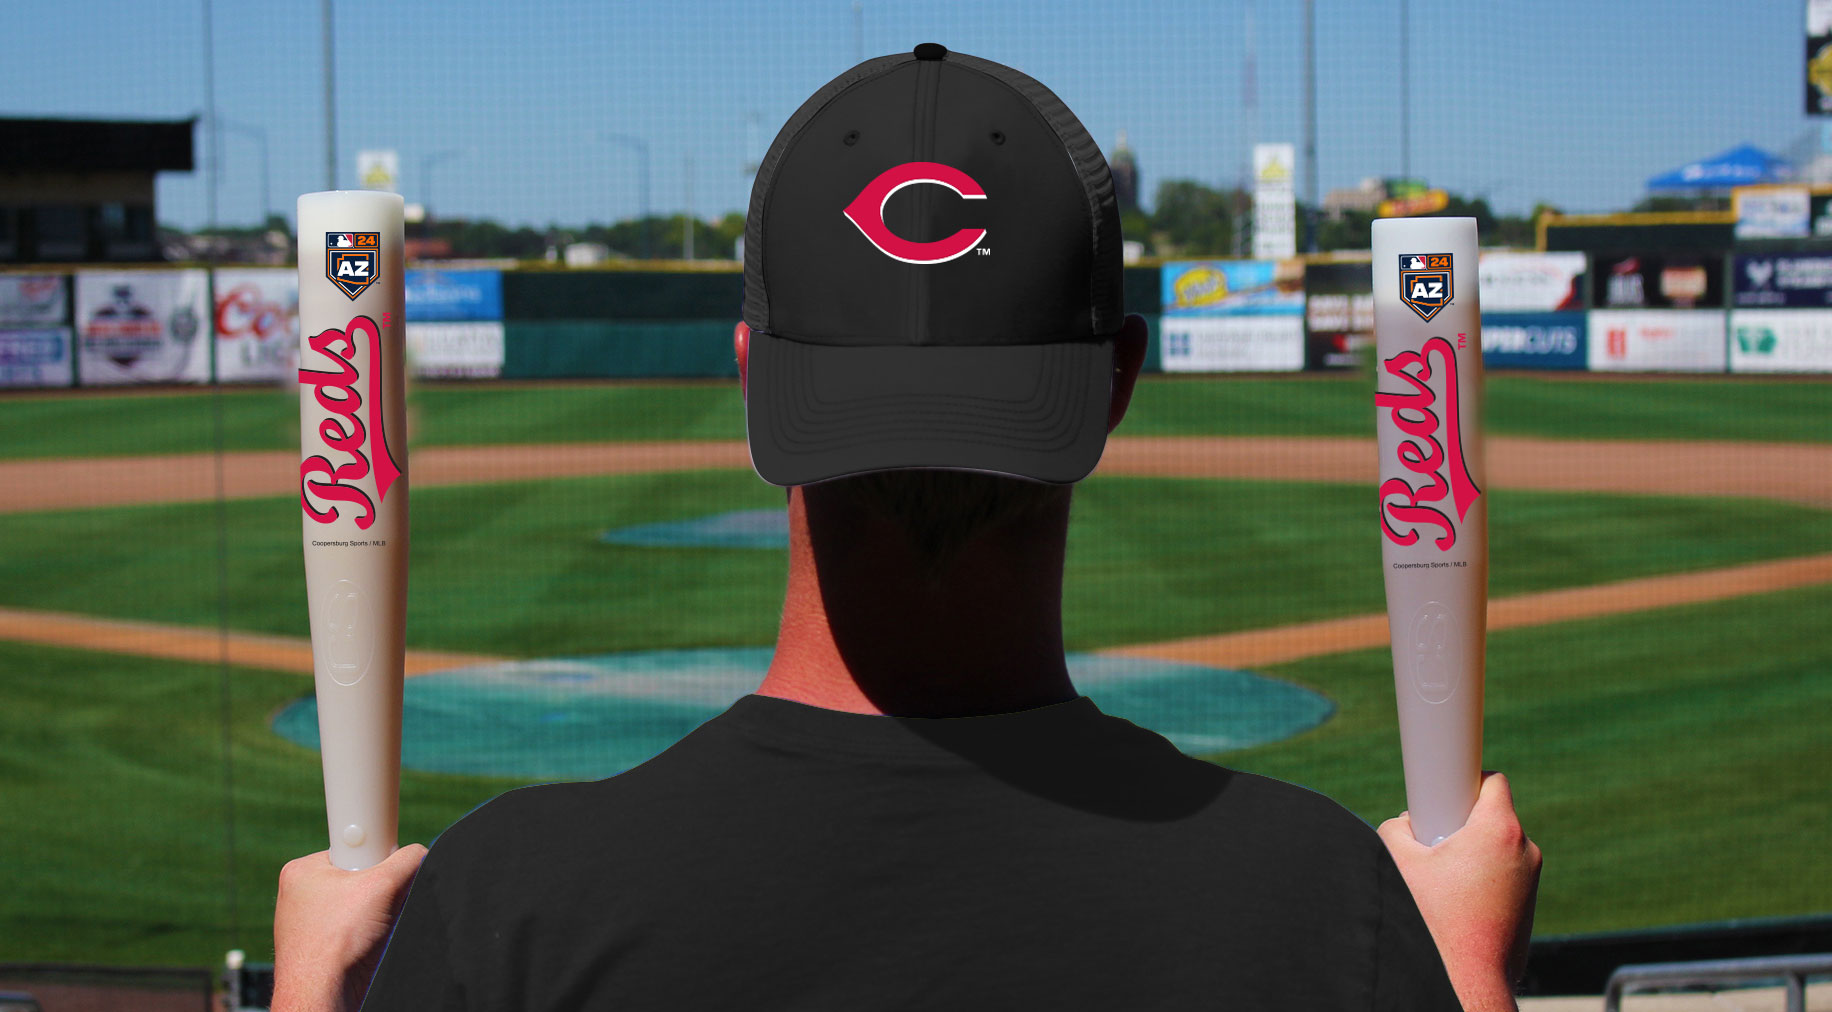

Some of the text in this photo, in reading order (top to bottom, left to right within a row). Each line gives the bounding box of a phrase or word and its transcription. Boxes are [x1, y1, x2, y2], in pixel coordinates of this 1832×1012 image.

[843, 161, 991, 265] C TM
[357, 235, 376, 246] 24
[337, 260, 369, 277] AZ
[1430, 256, 1449, 267] 24
[1411, 282, 1443, 299] AZ
[1481, 326, 1577, 354] PERCUTS
[298, 311, 402, 531] Reds TM
[1375, 332, 1482, 552] Reds TM
